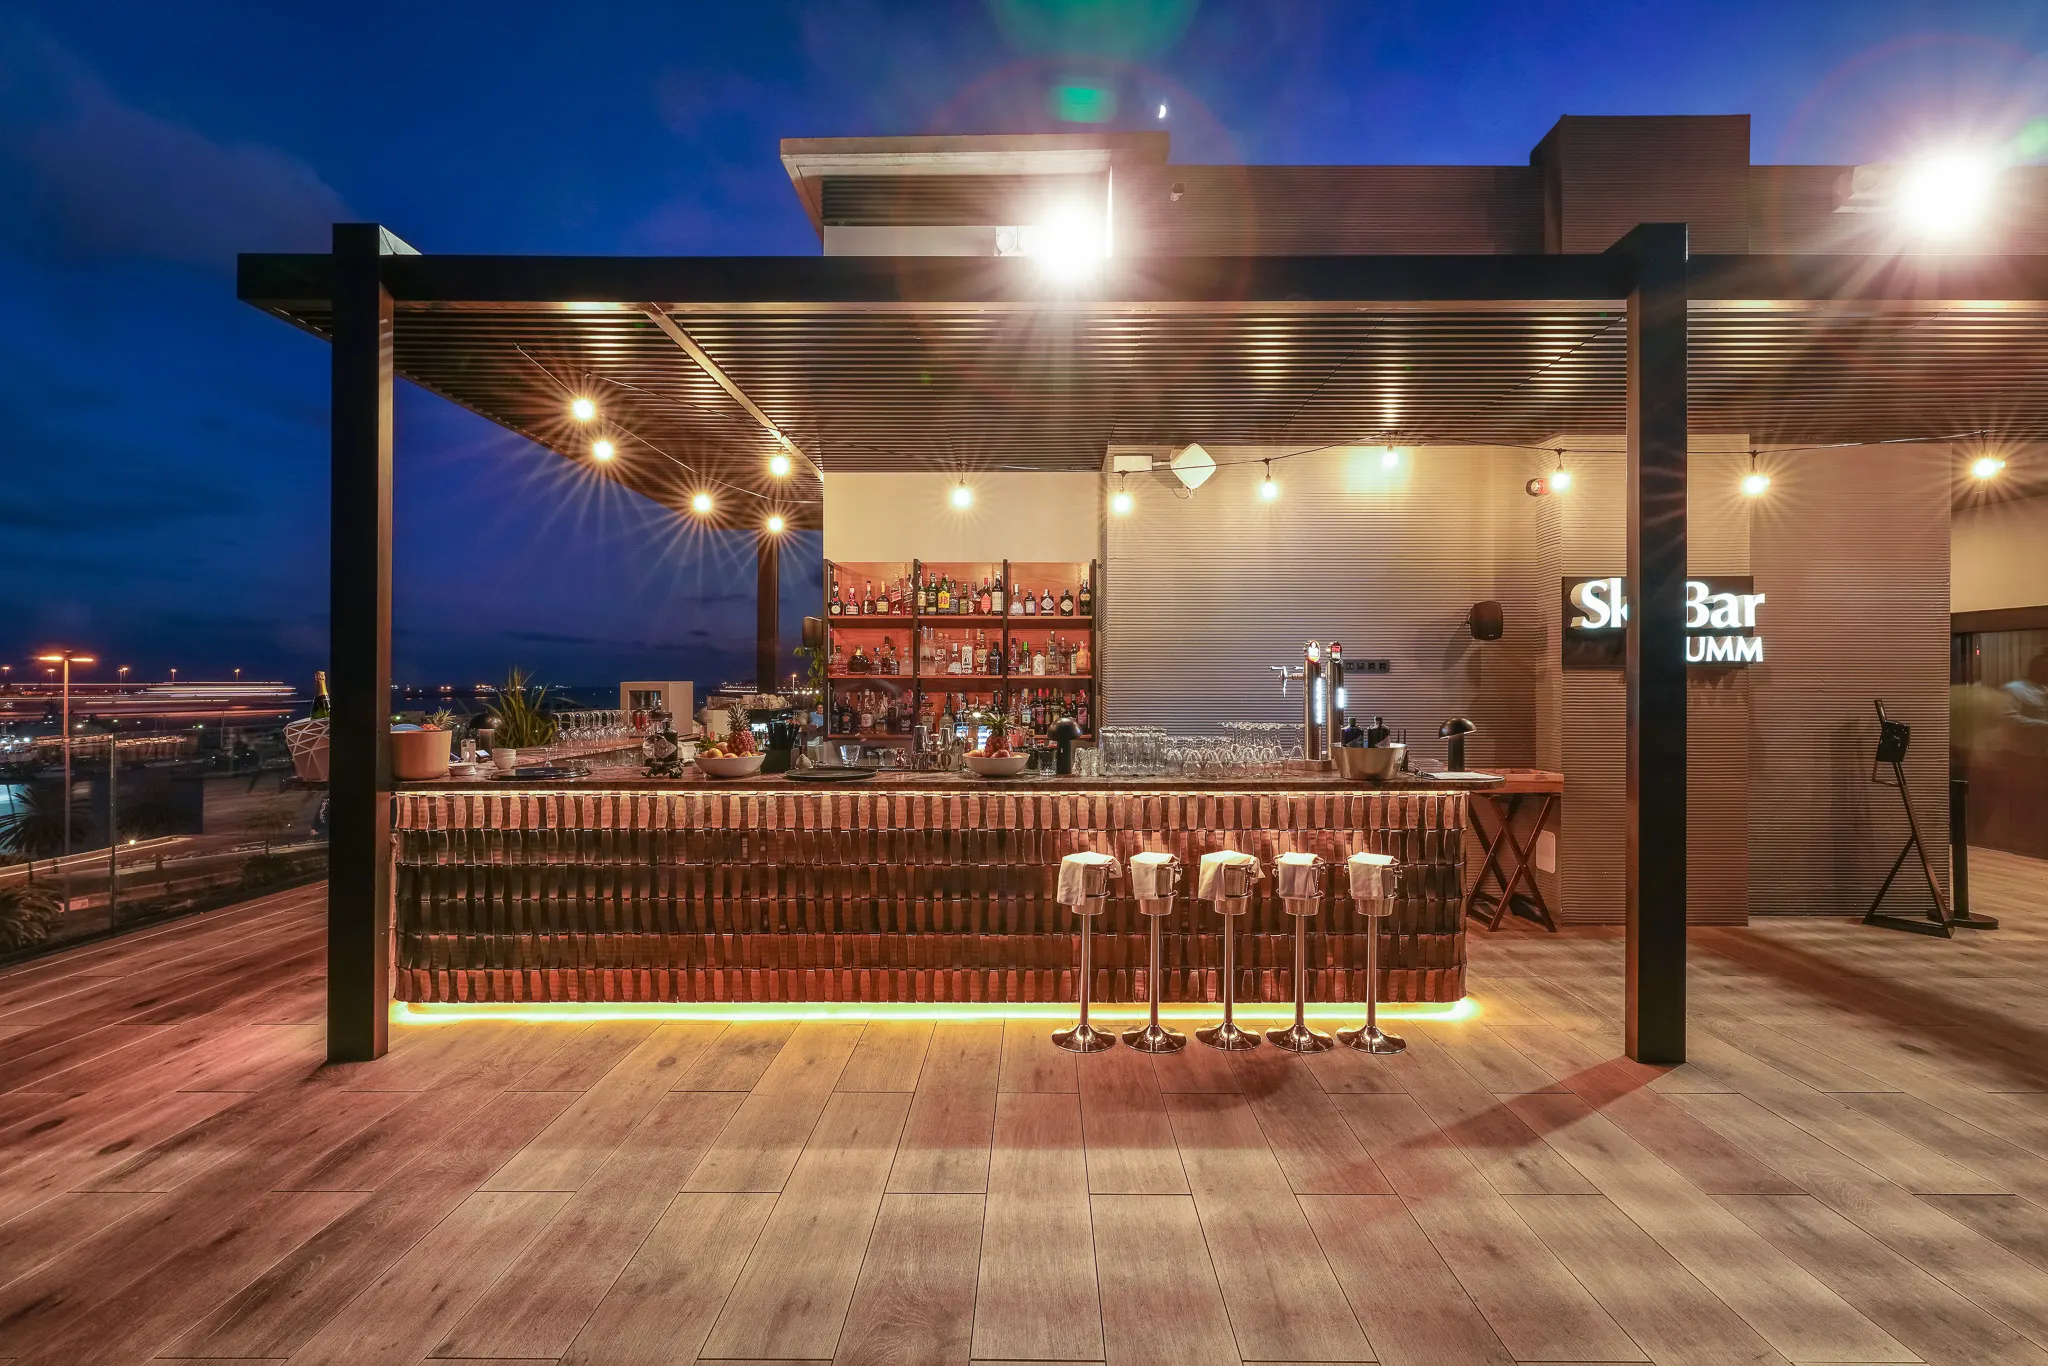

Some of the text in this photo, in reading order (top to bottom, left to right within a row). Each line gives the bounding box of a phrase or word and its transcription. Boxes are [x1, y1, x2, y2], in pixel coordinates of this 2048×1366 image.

[1580, 577, 1766, 629] Sk Bar
[1686, 635, 1764, 663] UMM
